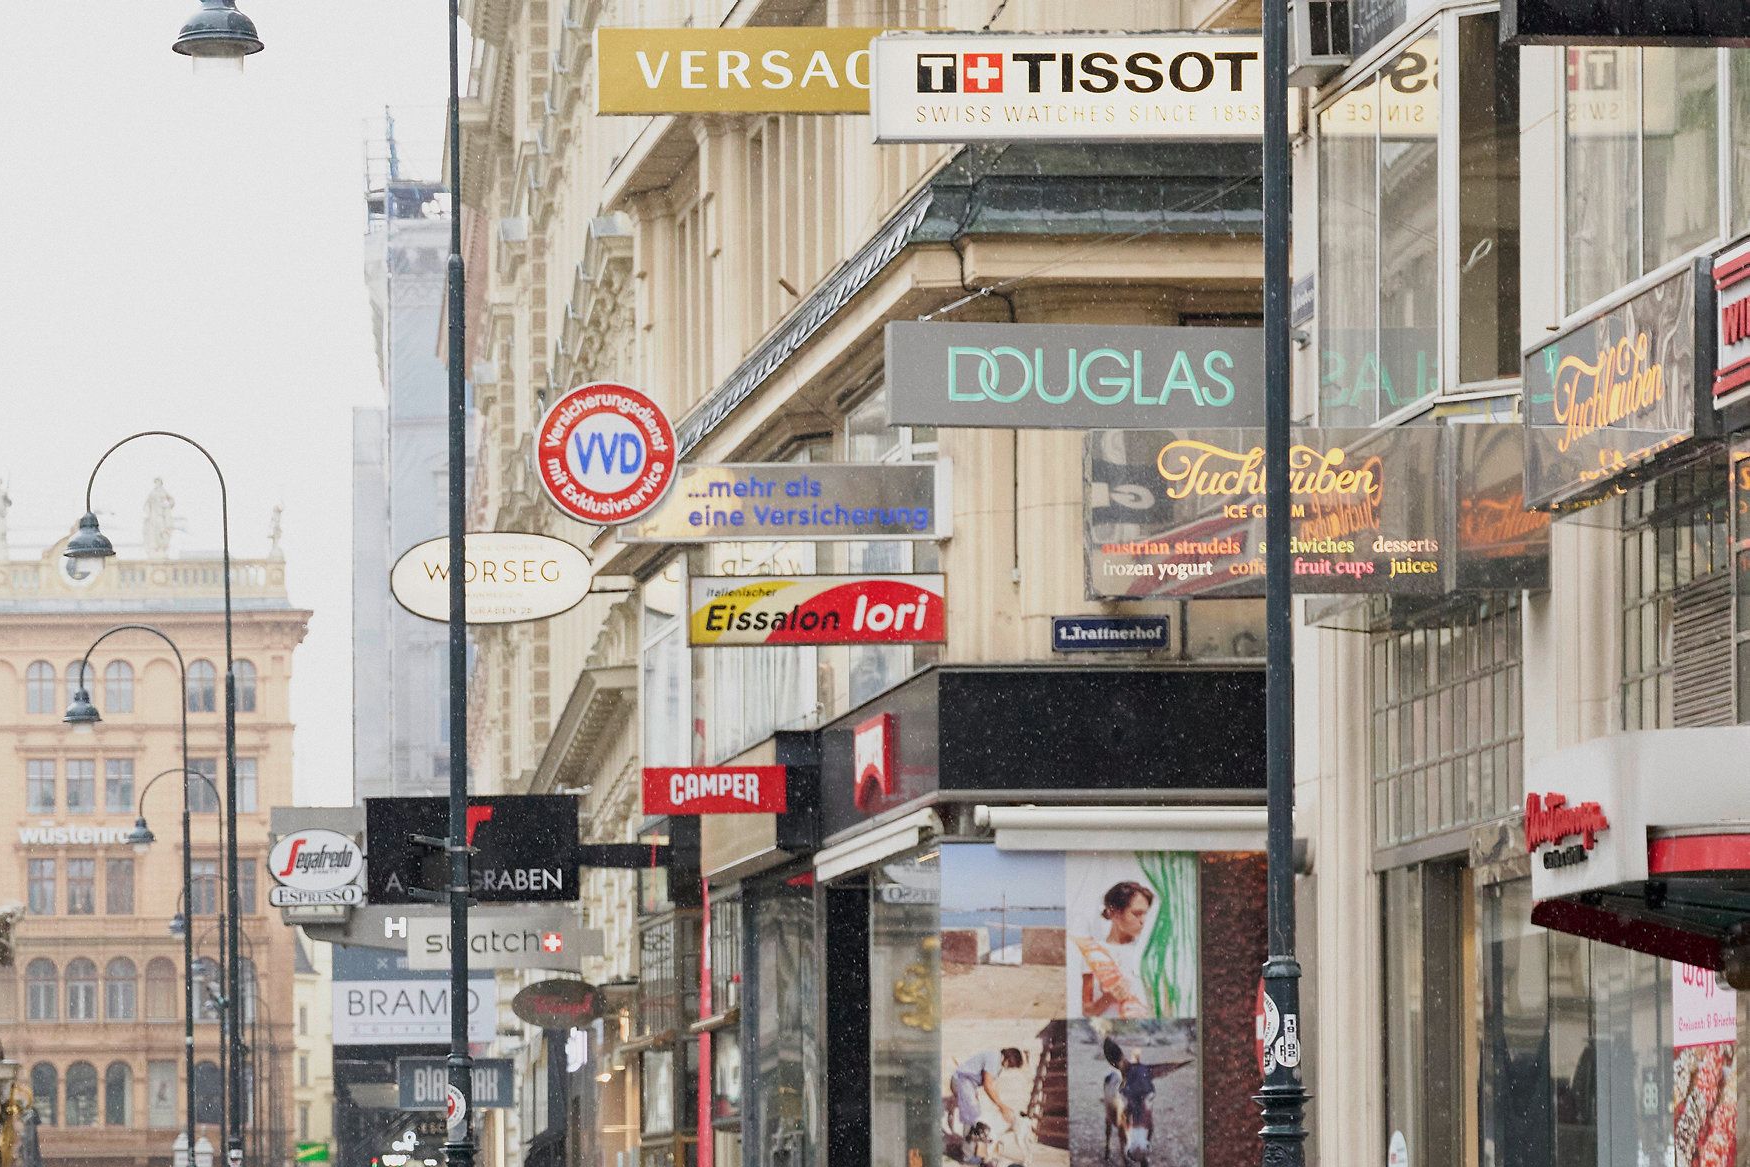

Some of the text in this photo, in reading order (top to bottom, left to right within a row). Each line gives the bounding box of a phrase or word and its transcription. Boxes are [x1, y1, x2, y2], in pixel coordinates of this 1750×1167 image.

[635, 50, 871, 89] VERSAC
[1012, 52, 1258, 93] TISSOT
[916, 105, 1261, 123] SWISS WATCHES SINCE 1853
[948, 346, 1235, 407] DOUGLAS
[1554, 332, 1664, 452] Tuchlauben
[545, 393, 668, 452] Versicherungsdienst
[574, 431, 642, 475] VVD
[547, 457, 665, 515] mit Exklusivservice
[785, 475, 822, 498] als
[688, 504, 929, 530] eine Versicherung
[1224, 504, 1248, 519] ICE
[1101, 539, 1170, 555] austrian
[1175, 536, 1241, 555] strudels
[1372, 536, 1439, 554] desserts
[1102, 560, 1154, 576] frozen
[1157, 562, 1214, 581] yogurt
[1294, 557, 1332, 577] fruit
[1335, 561, 1375, 580] cups
[1389, 558, 1438, 578] juices
[705, 604, 840, 632] Eissalon
[670, 773, 760, 806] CAMPER
[279, 839, 353, 876] Segafredo
[279, 889, 355, 903] ESPRESSO
